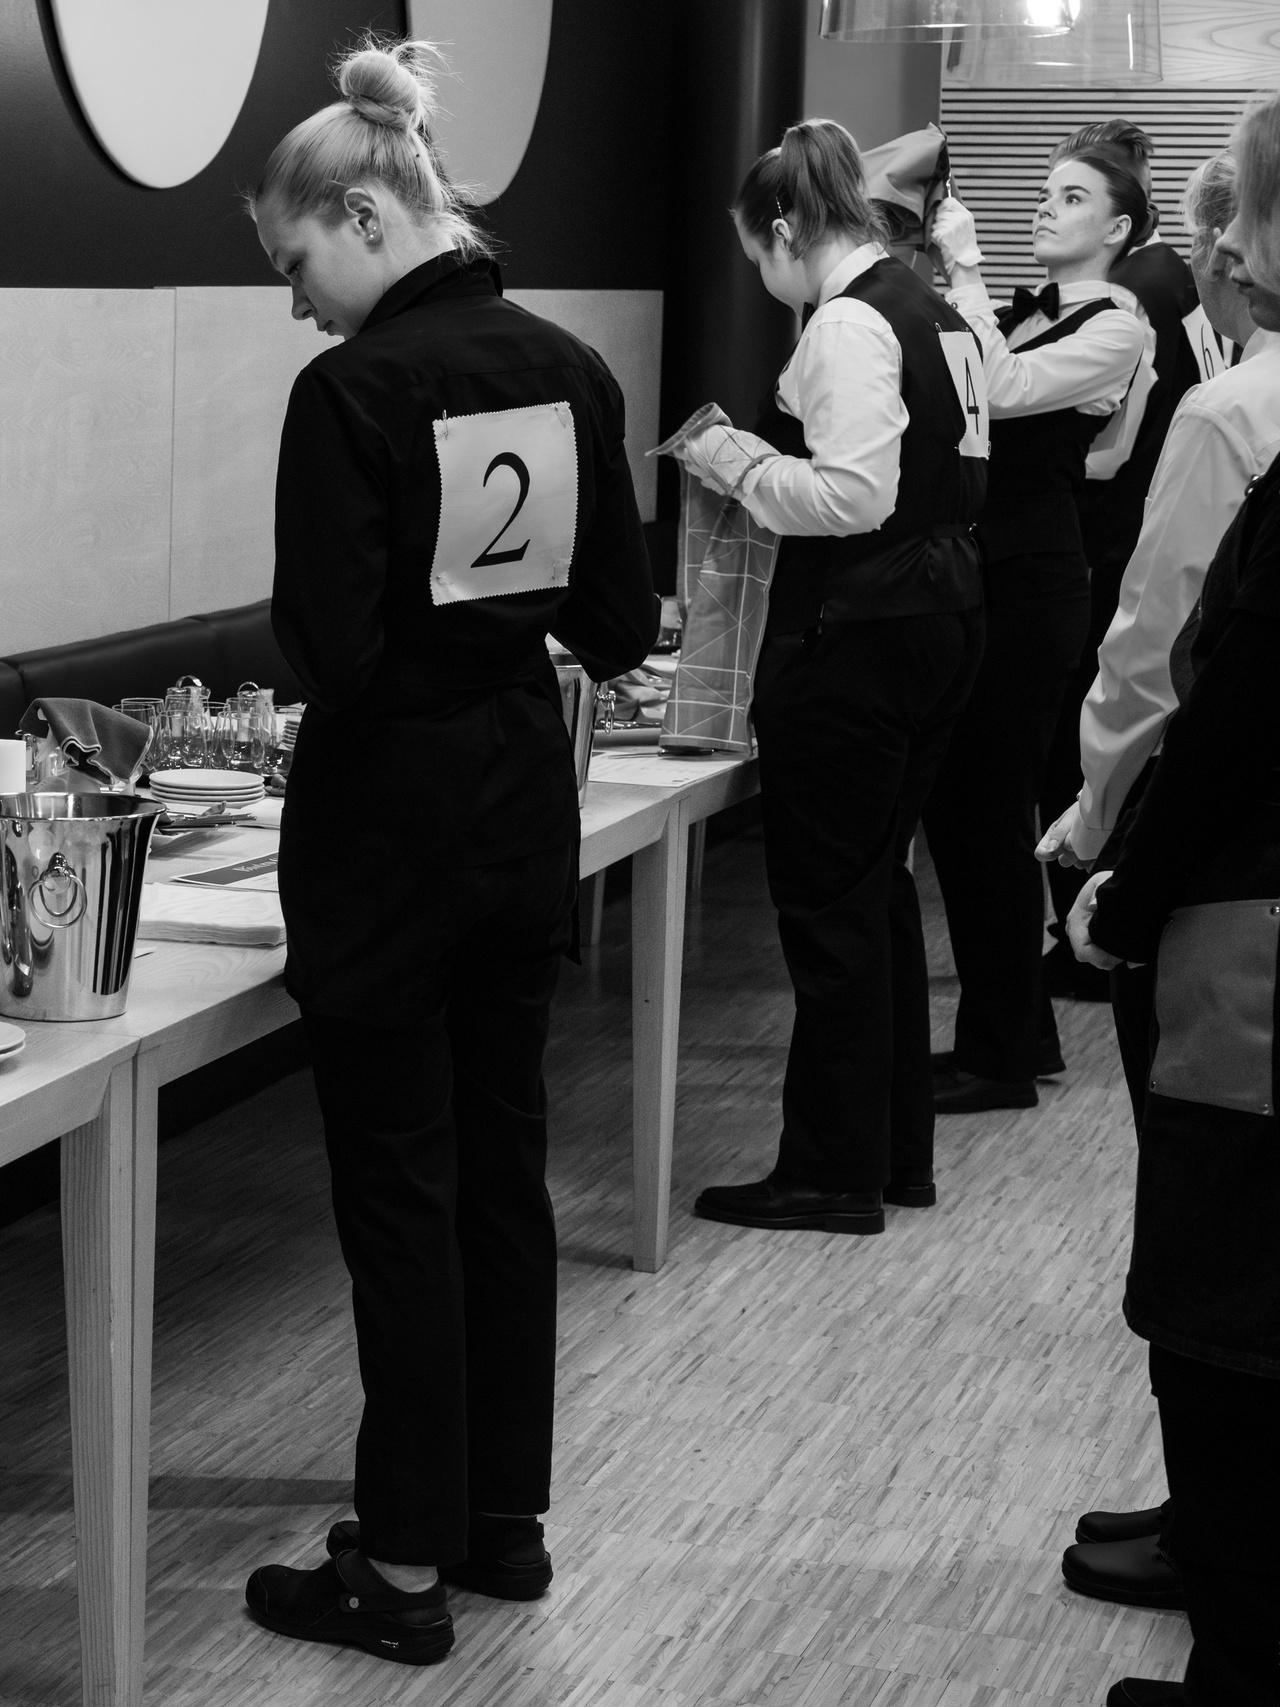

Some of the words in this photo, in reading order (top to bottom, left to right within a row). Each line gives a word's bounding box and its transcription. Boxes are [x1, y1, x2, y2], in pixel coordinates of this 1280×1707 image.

[1200, 323, 1215, 381] 6
[965, 356, 980, 435] 4
[470, 451, 531, 569] 2
